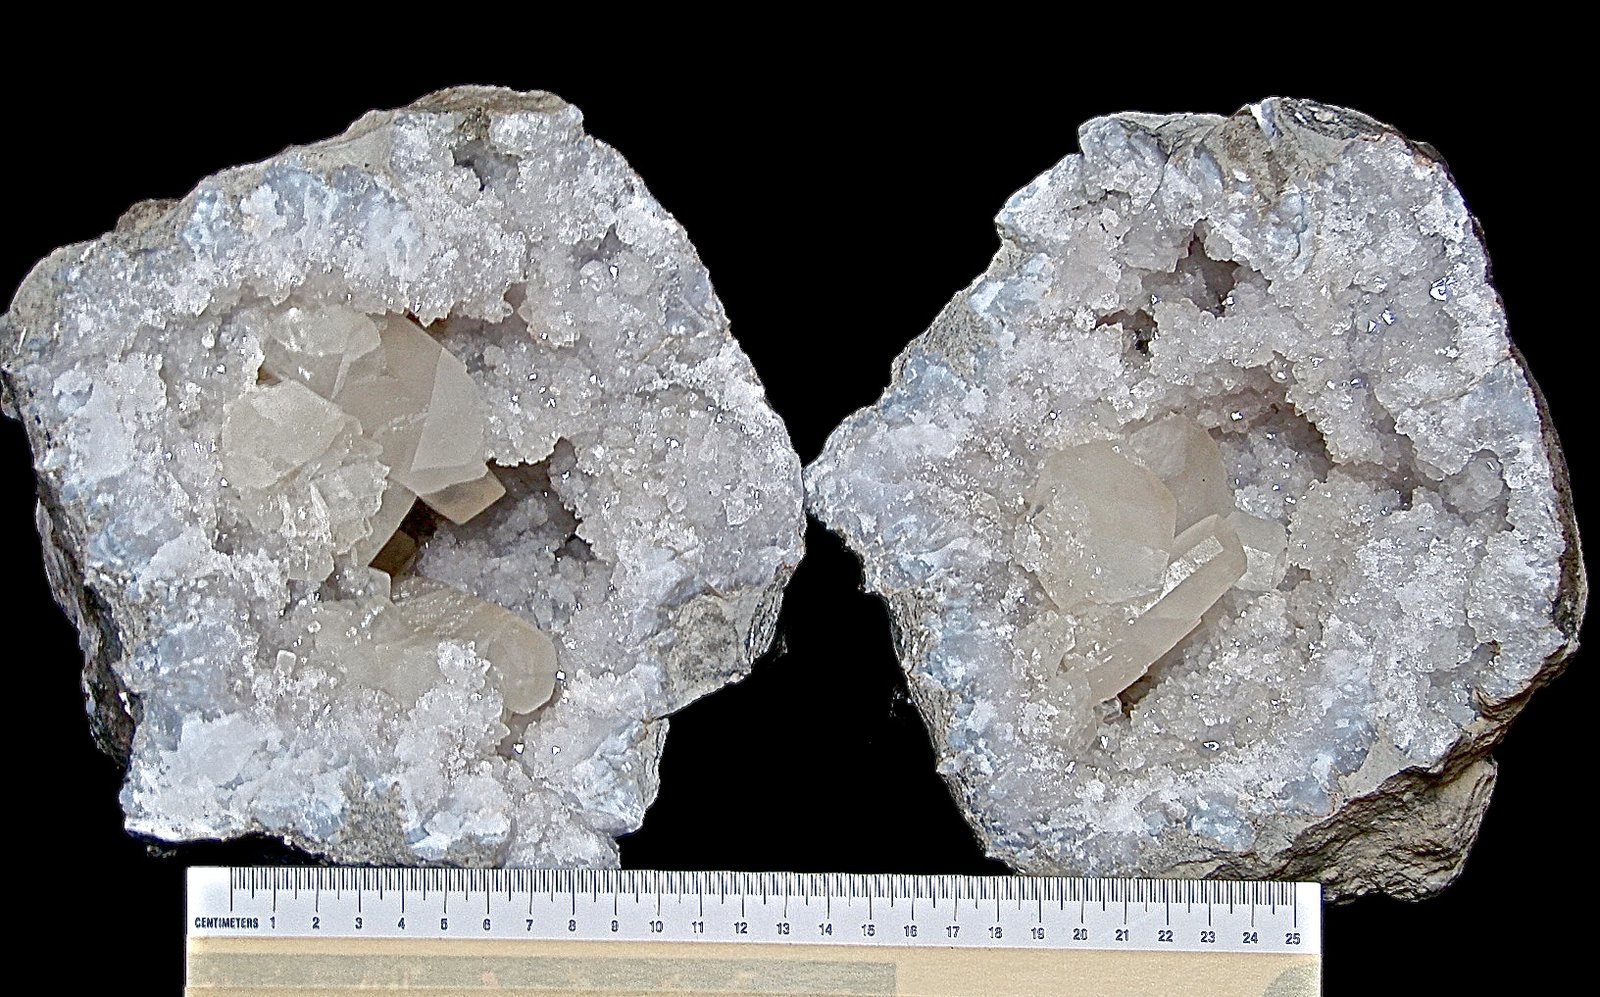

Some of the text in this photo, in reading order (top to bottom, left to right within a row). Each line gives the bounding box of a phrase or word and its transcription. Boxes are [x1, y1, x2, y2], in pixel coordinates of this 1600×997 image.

[194, 916, 1300, 945] CENTIMETERS 1 2 3 4 5 6 7 8 9 10 11 12 13 14 15 16 17 18 19 20 21 22 23 24 25
